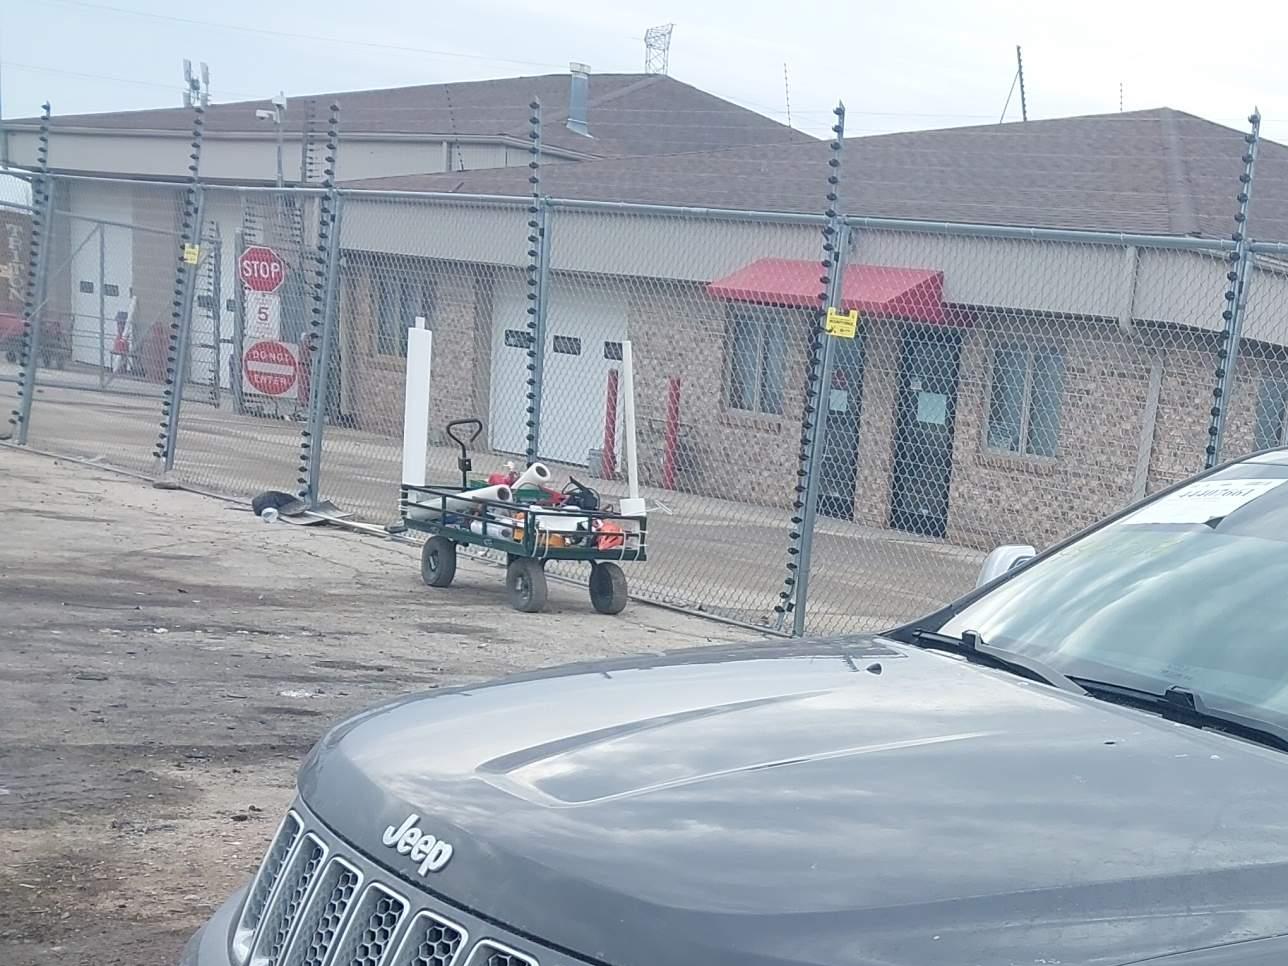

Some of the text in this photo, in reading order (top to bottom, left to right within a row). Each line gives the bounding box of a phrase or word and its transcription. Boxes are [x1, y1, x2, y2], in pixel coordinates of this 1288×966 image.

[242, 260, 281, 279] STOP
[258, 306, 269, 321] 5
[252, 350, 290, 362] DO NOT
[254, 374, 287, 386] ENTER
[382, 813, 454, 878] Jeep
